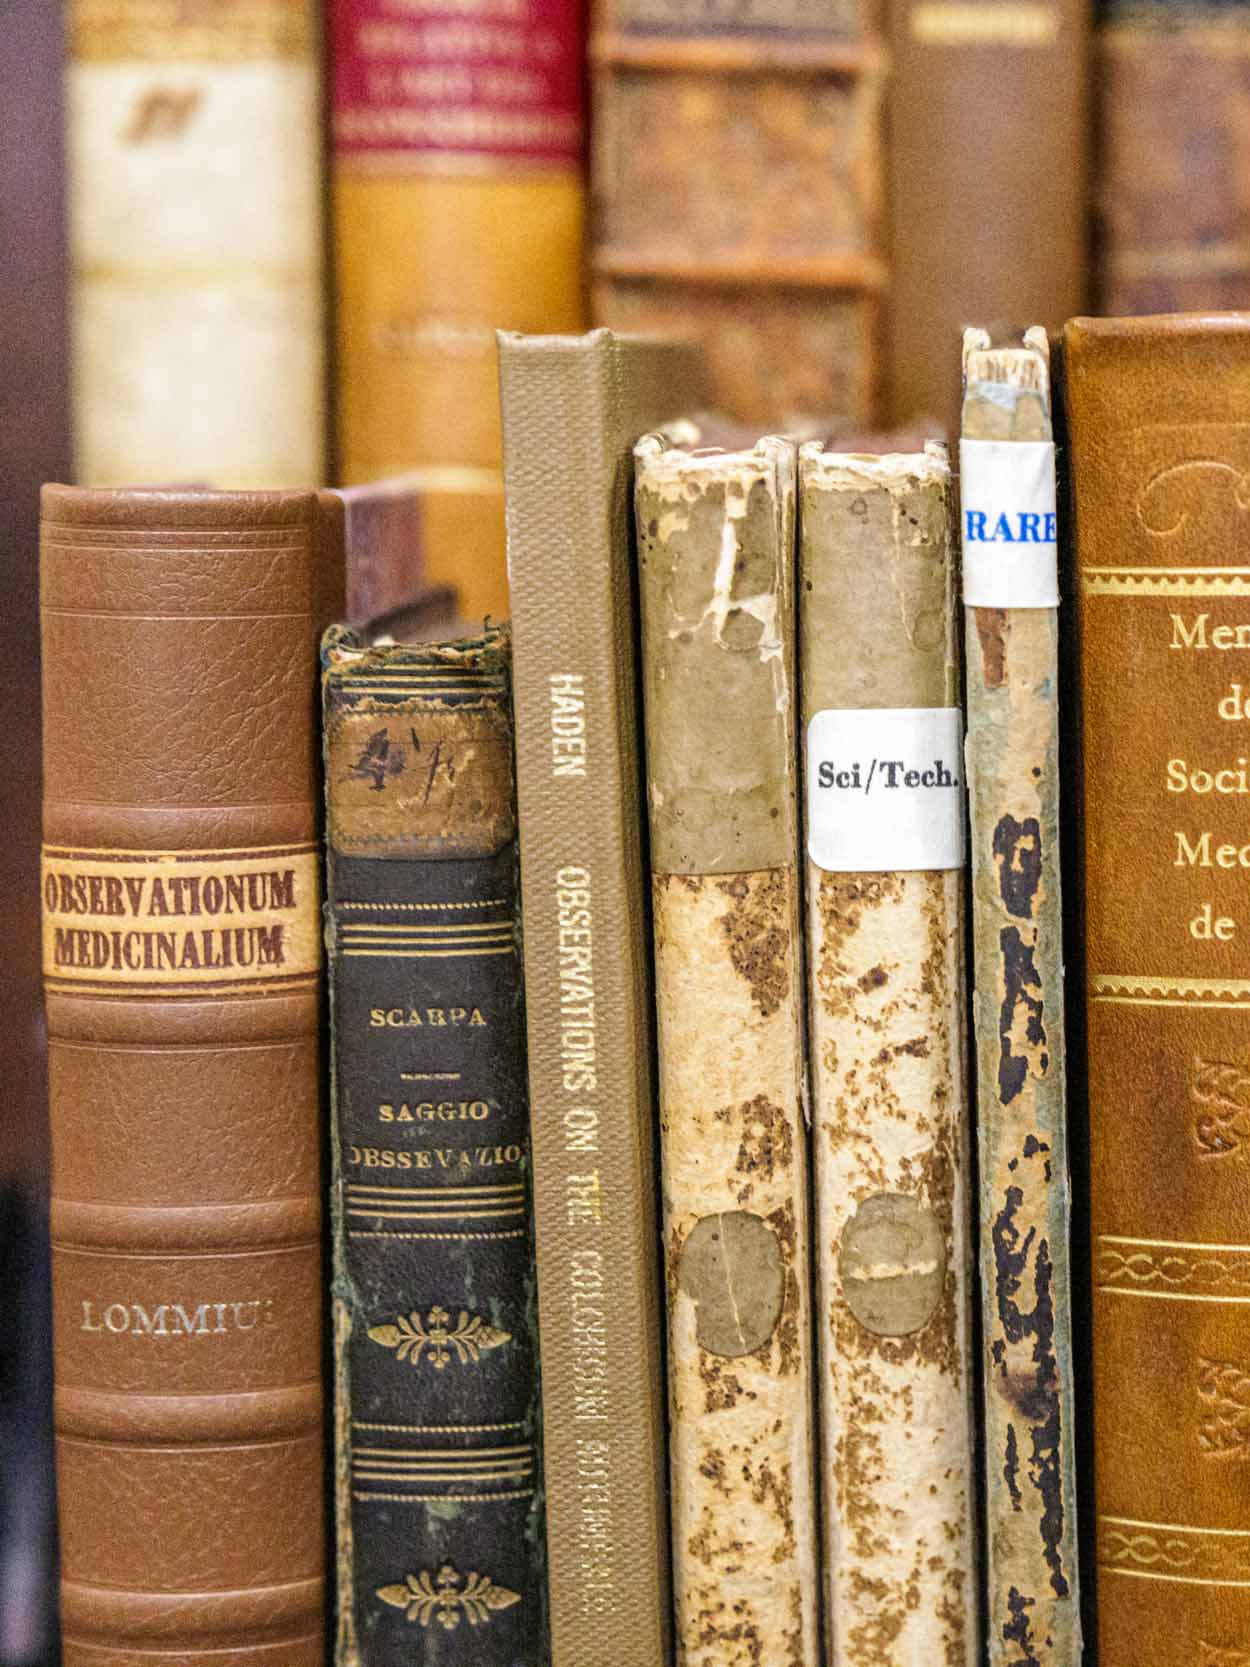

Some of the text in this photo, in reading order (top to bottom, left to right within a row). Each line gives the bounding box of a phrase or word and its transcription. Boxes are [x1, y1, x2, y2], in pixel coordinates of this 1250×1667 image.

[965, 510, 1057, 542] RARE
[549, 673, 587, 777] HADEN
[818, 759, 960, 795] Sci/Tech.
[45, 869, 297, 917] OBSERVATIONUM
[1190, 902, 1236, 940] de
[54, 924, 285, 970] MEDICINALIUM
[556, 866, 598, 1091] OBSERVATIONS
[370, 1008, 487, 1028] SCARPA
[378, 1101, 490, 1122] SAGGIO
[563, 1109, 599, 1151] ON
[567, 1168, 601, 1226] THE
